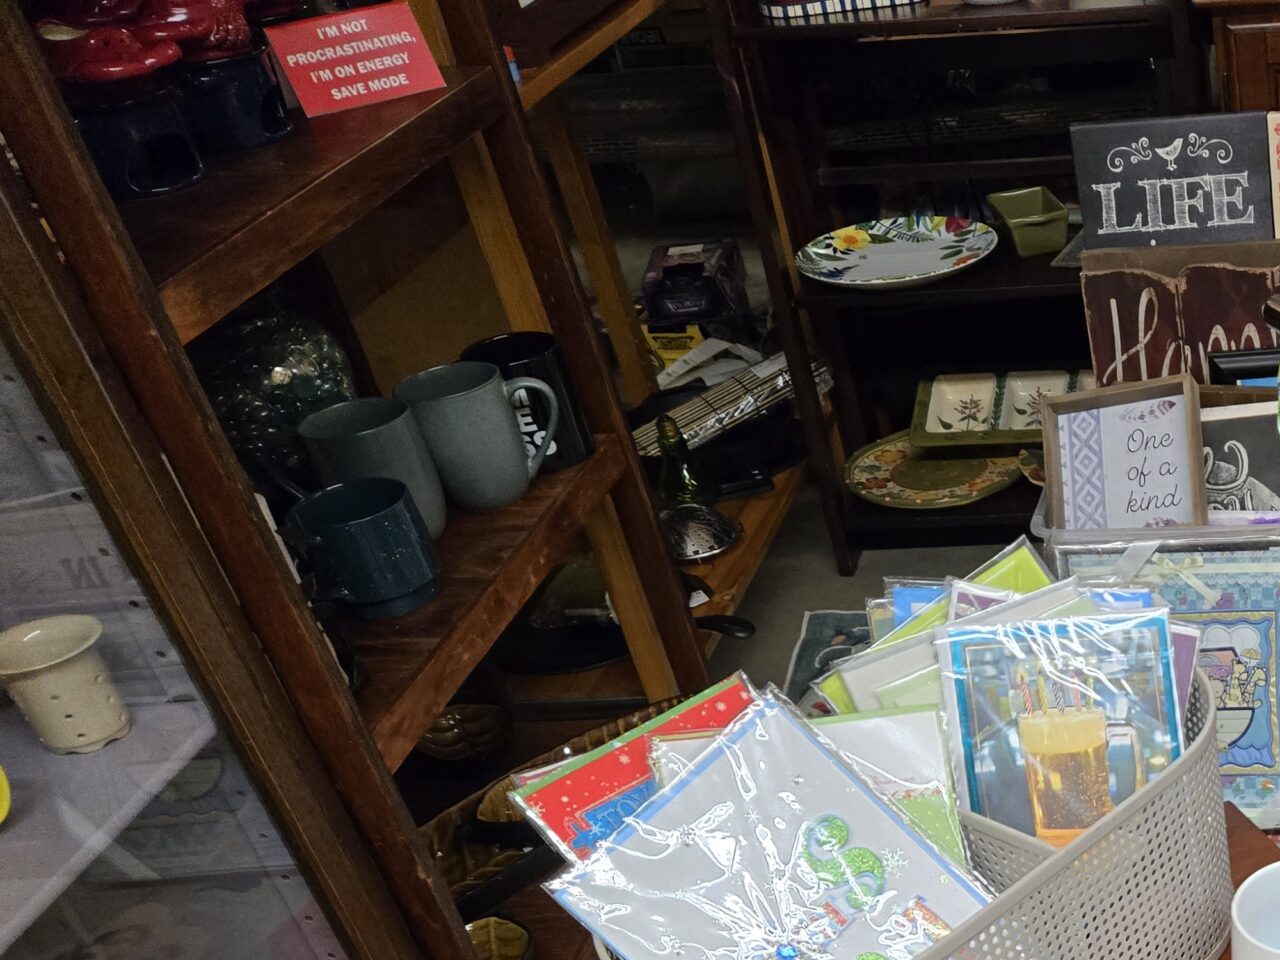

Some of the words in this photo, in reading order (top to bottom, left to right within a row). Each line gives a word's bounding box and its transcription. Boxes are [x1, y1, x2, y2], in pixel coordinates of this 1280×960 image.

[316, 27, 339, 40] I'M
[341, 19, 369, 36] NOT
[286, 31, 417, 67] PROCRASTINATING,
[309, 68, 334, 83] I'M
[334, 64, 356, 79] ON
[357, 52, 411, 74] ENERGY
[330, 82, 368, 100] SAVE
[368, 73, 410, 92] MODE
[1091, 170, 1257, 235] LIFE
[1126, 428, 1174, 454] One
[1128, 456, 1151, 487] of
[1159, 462, 1178, 477] a
[1126, 484, 1182, 514] kind
